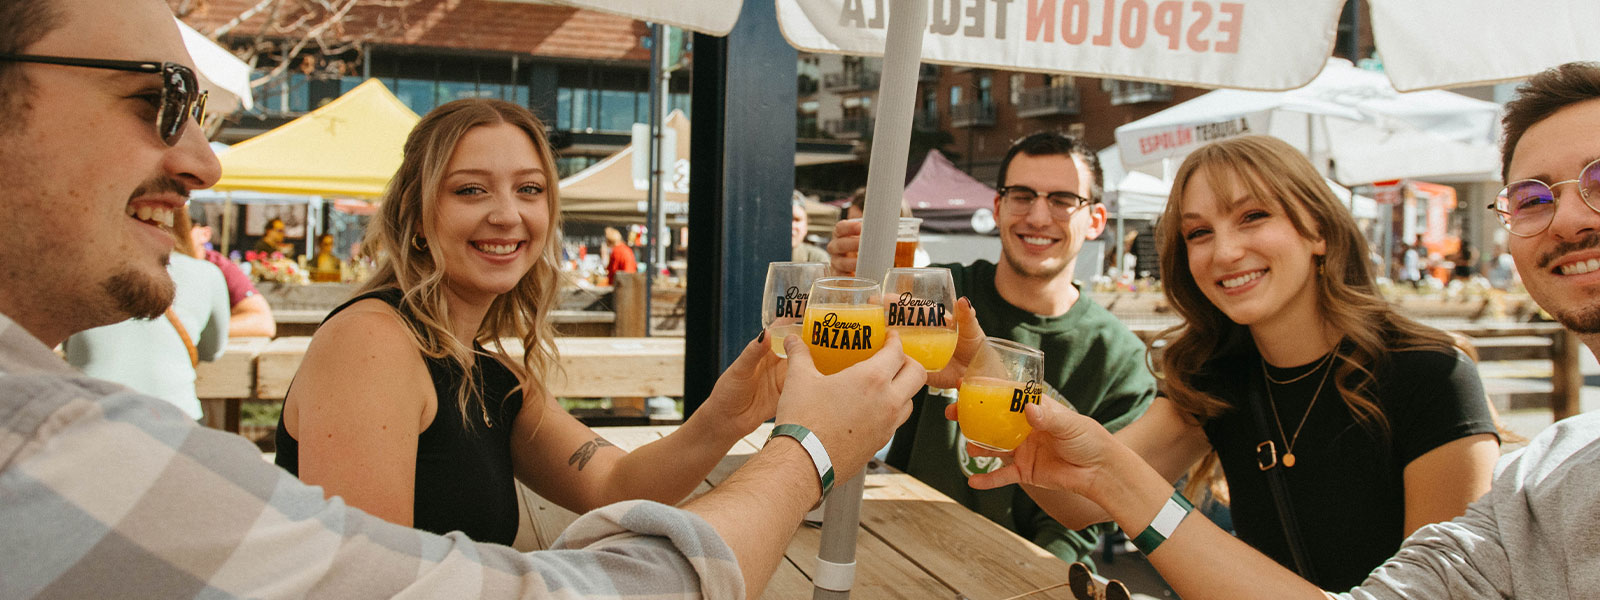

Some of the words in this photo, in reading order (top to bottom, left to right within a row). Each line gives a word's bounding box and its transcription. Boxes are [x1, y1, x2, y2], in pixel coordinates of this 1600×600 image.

[785, 286, 810, 301] Den
[898, 291, 937, 307] Denver
[775, 296, 807, 318] BAZ
[888, 302, 947, 327] BAZAAR
[822, 312, 862, 330] Denver
[811, 321, 872, 350] BAZAAR
[1009, 388, 1041, 413] BAZ
